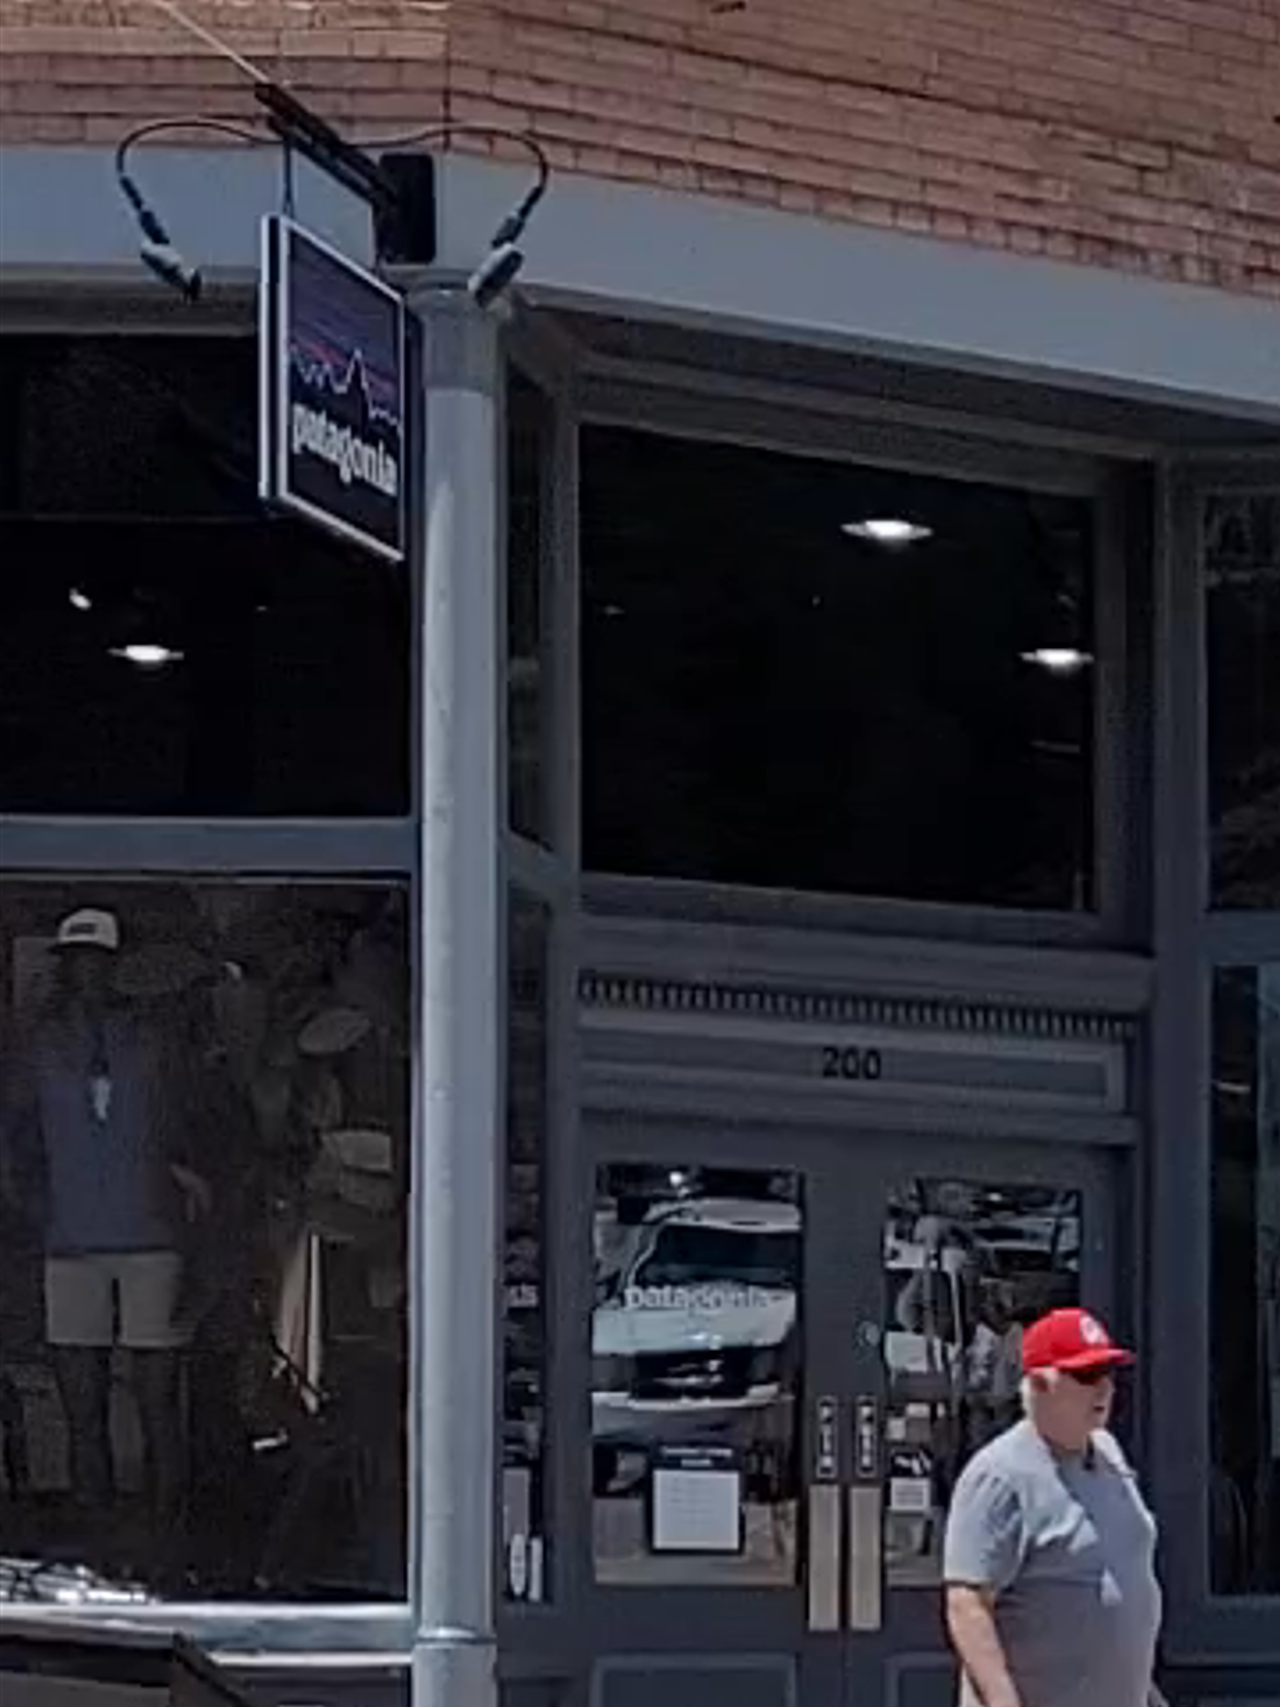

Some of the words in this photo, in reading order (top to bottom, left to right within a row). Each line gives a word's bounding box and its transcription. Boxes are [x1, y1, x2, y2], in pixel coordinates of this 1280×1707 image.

[293, 403, 398, 497] patagonia
[823, 1045, 882, 1080] 200
[623, 1283, 770, 1315] patagonia
